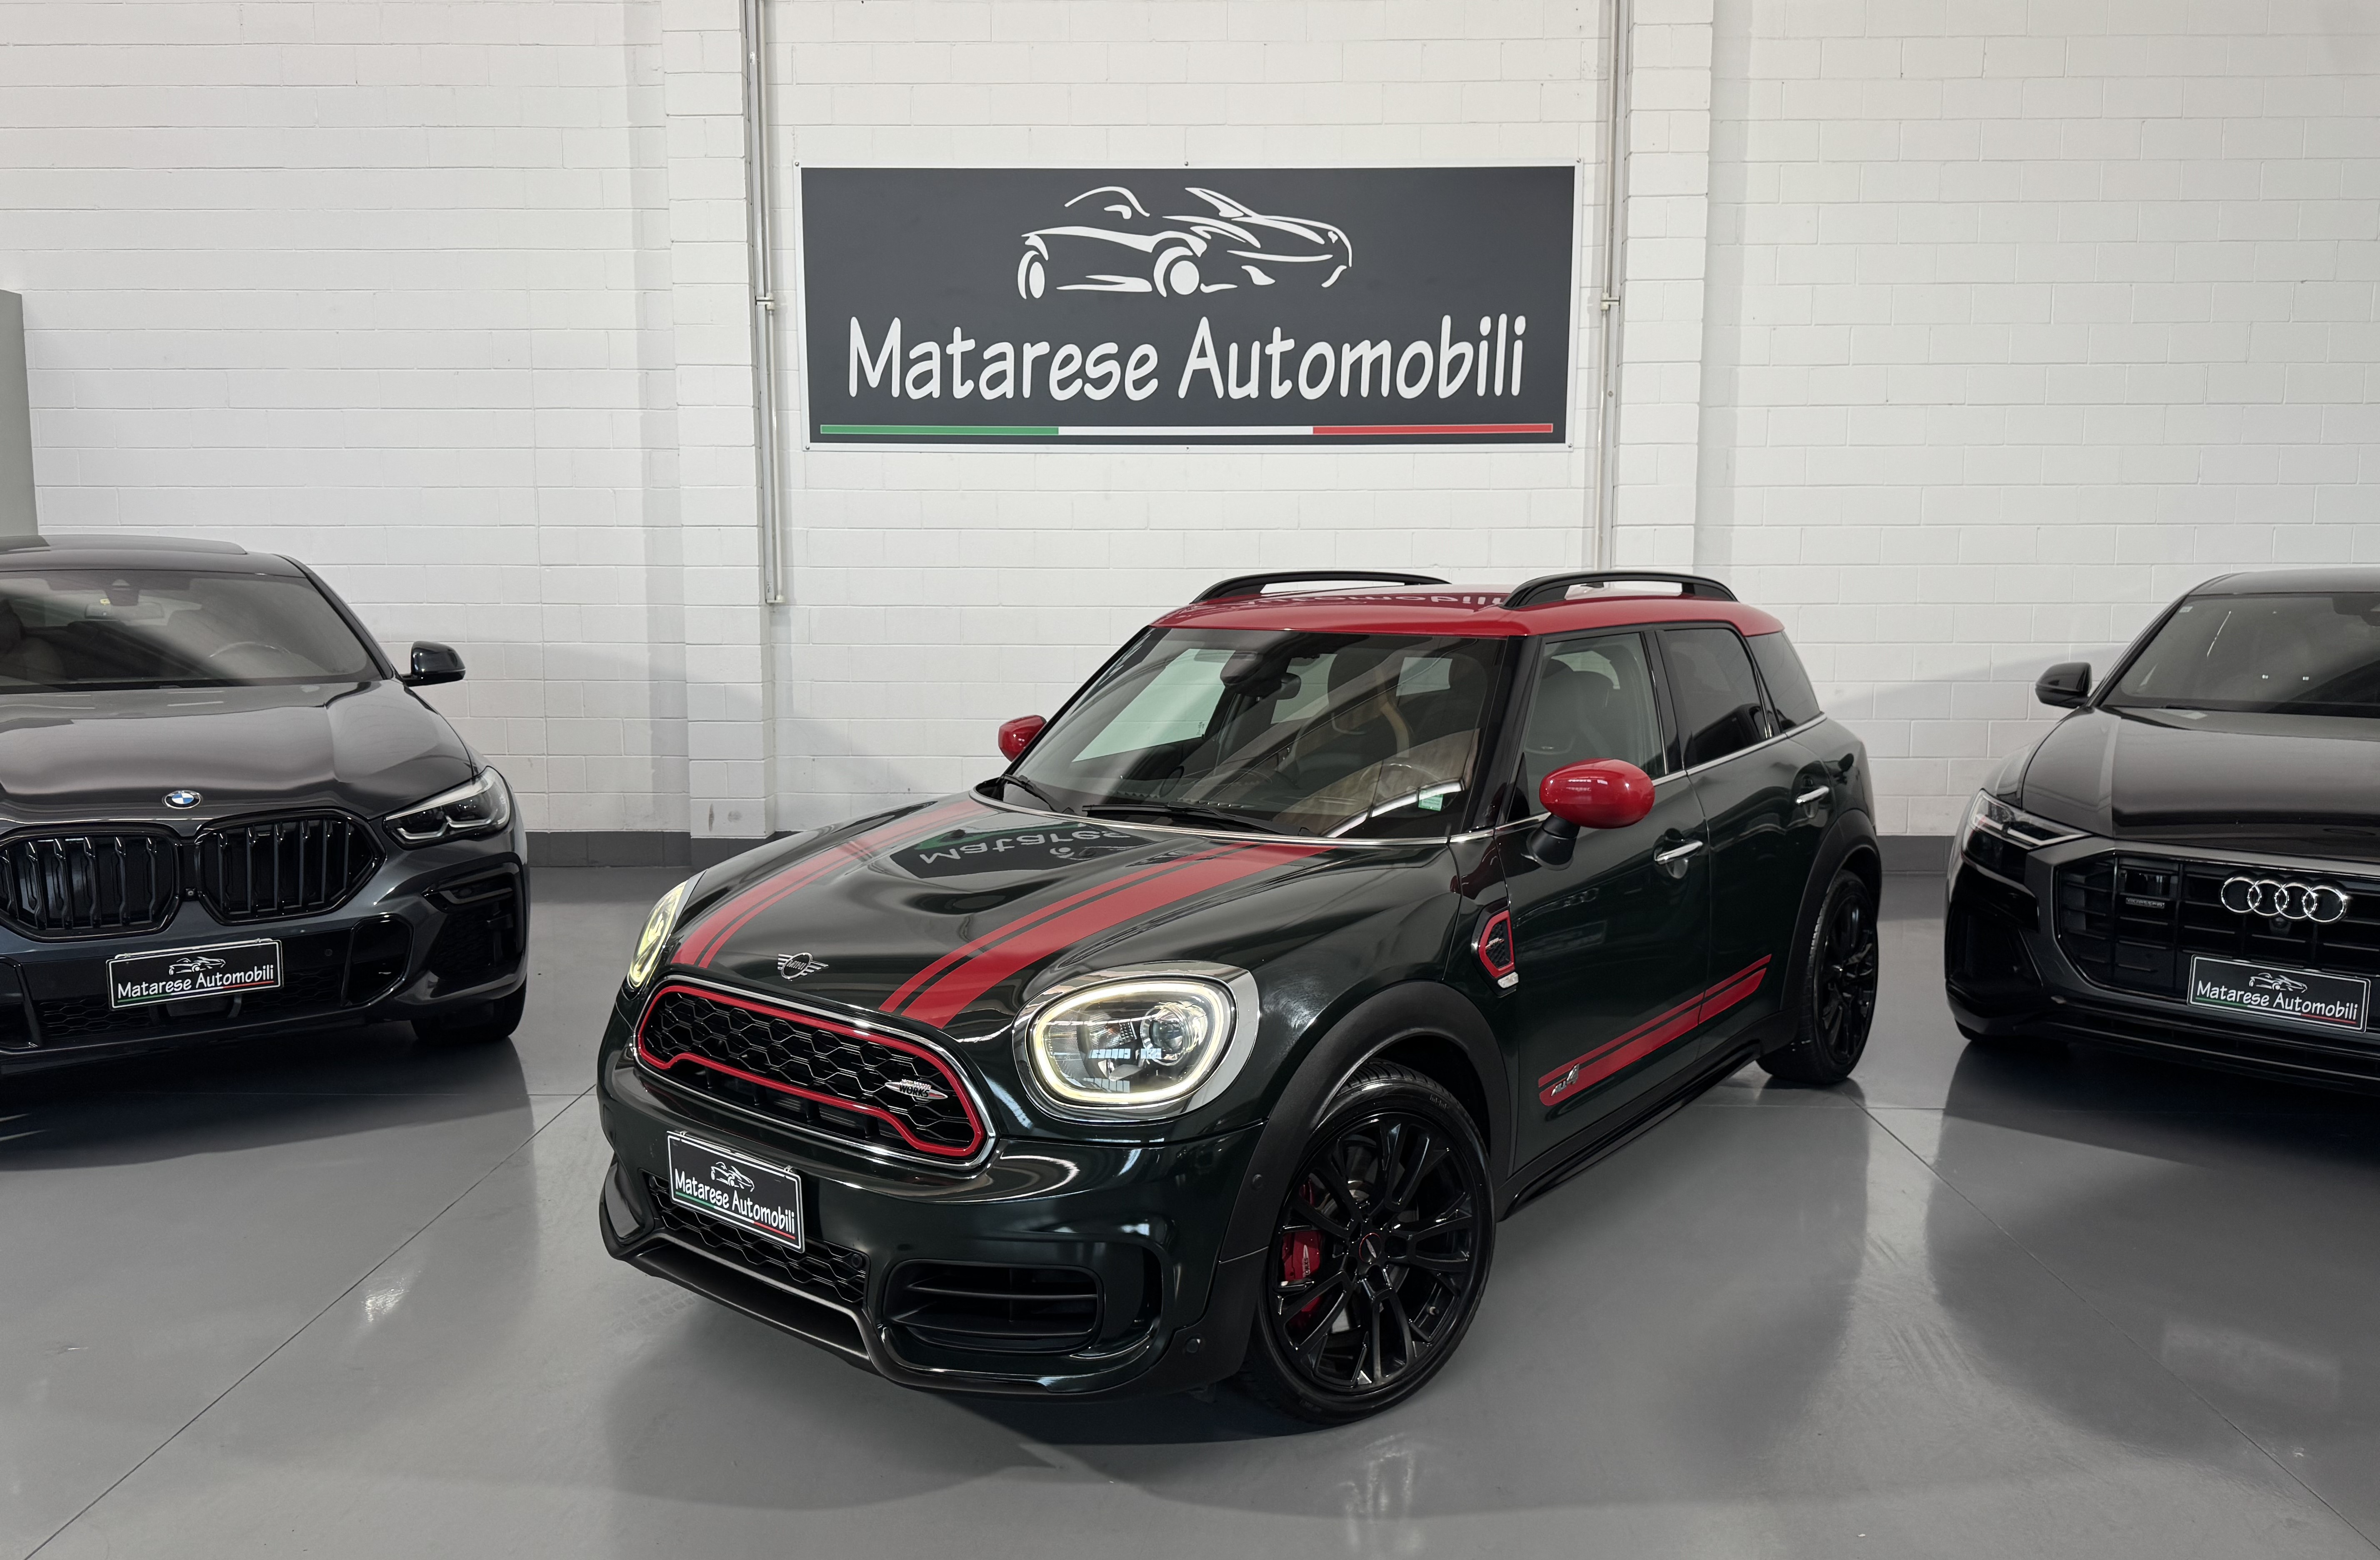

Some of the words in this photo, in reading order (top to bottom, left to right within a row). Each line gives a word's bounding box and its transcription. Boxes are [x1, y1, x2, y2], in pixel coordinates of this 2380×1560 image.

[849, 316, 1158, 401] Matarese
[1178, 313, 1526, 400] Automobili
[118, 979, 192, 999] Matarese
[196, 965, 274, 989] Automobili
[786, 960, 807, 970] MINI
[2197, 980, 2270, 1006] Matarese
[2273, 992, 2358, 1020] Automobili
[899, 1085, 930, 1098] WORKS
[675, 1168, 730, 1209] Matarese
[732, 1190, 795, 1234] Automobili
